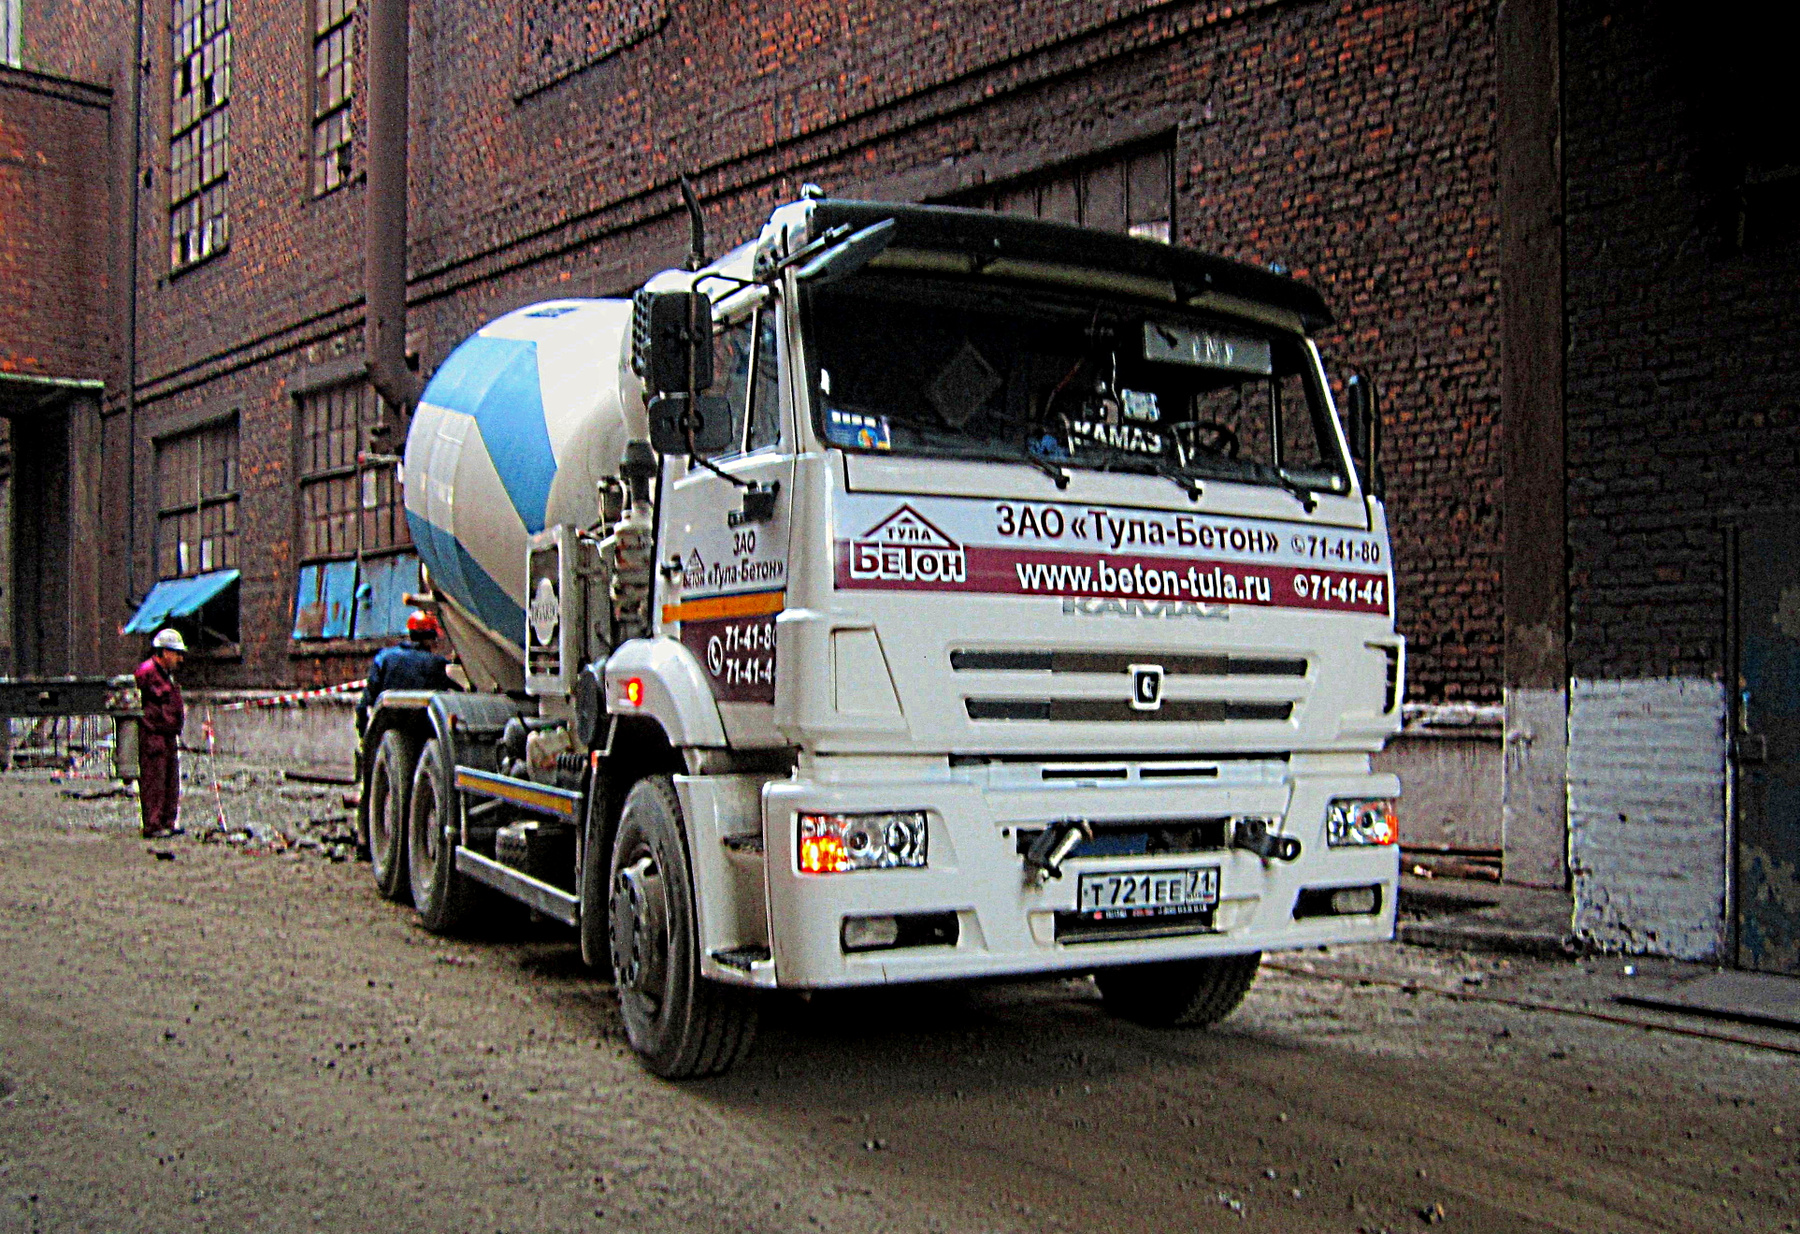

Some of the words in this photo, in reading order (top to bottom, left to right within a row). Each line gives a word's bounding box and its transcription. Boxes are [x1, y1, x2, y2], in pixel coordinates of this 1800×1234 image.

[733, 530, 756, 556] ЗАО
[995, 503, 1065, 539] ЗАО
[1071, 510, 1279, 552] «Тула-Бетон»
[850, 540, 966, 582] БЕТОН
[1307, 535, 1380, 564] 71-41-80
[708, 558, 783, 589] «Тула-Бетон»
[1015, 559, 1271, 602] www.beton-tula.ru
[1310, 574, 1383, 605] 71-41-44
[726, 657, 776, 685] 71-41-4
[1189, 870, 1210, 892] 71
